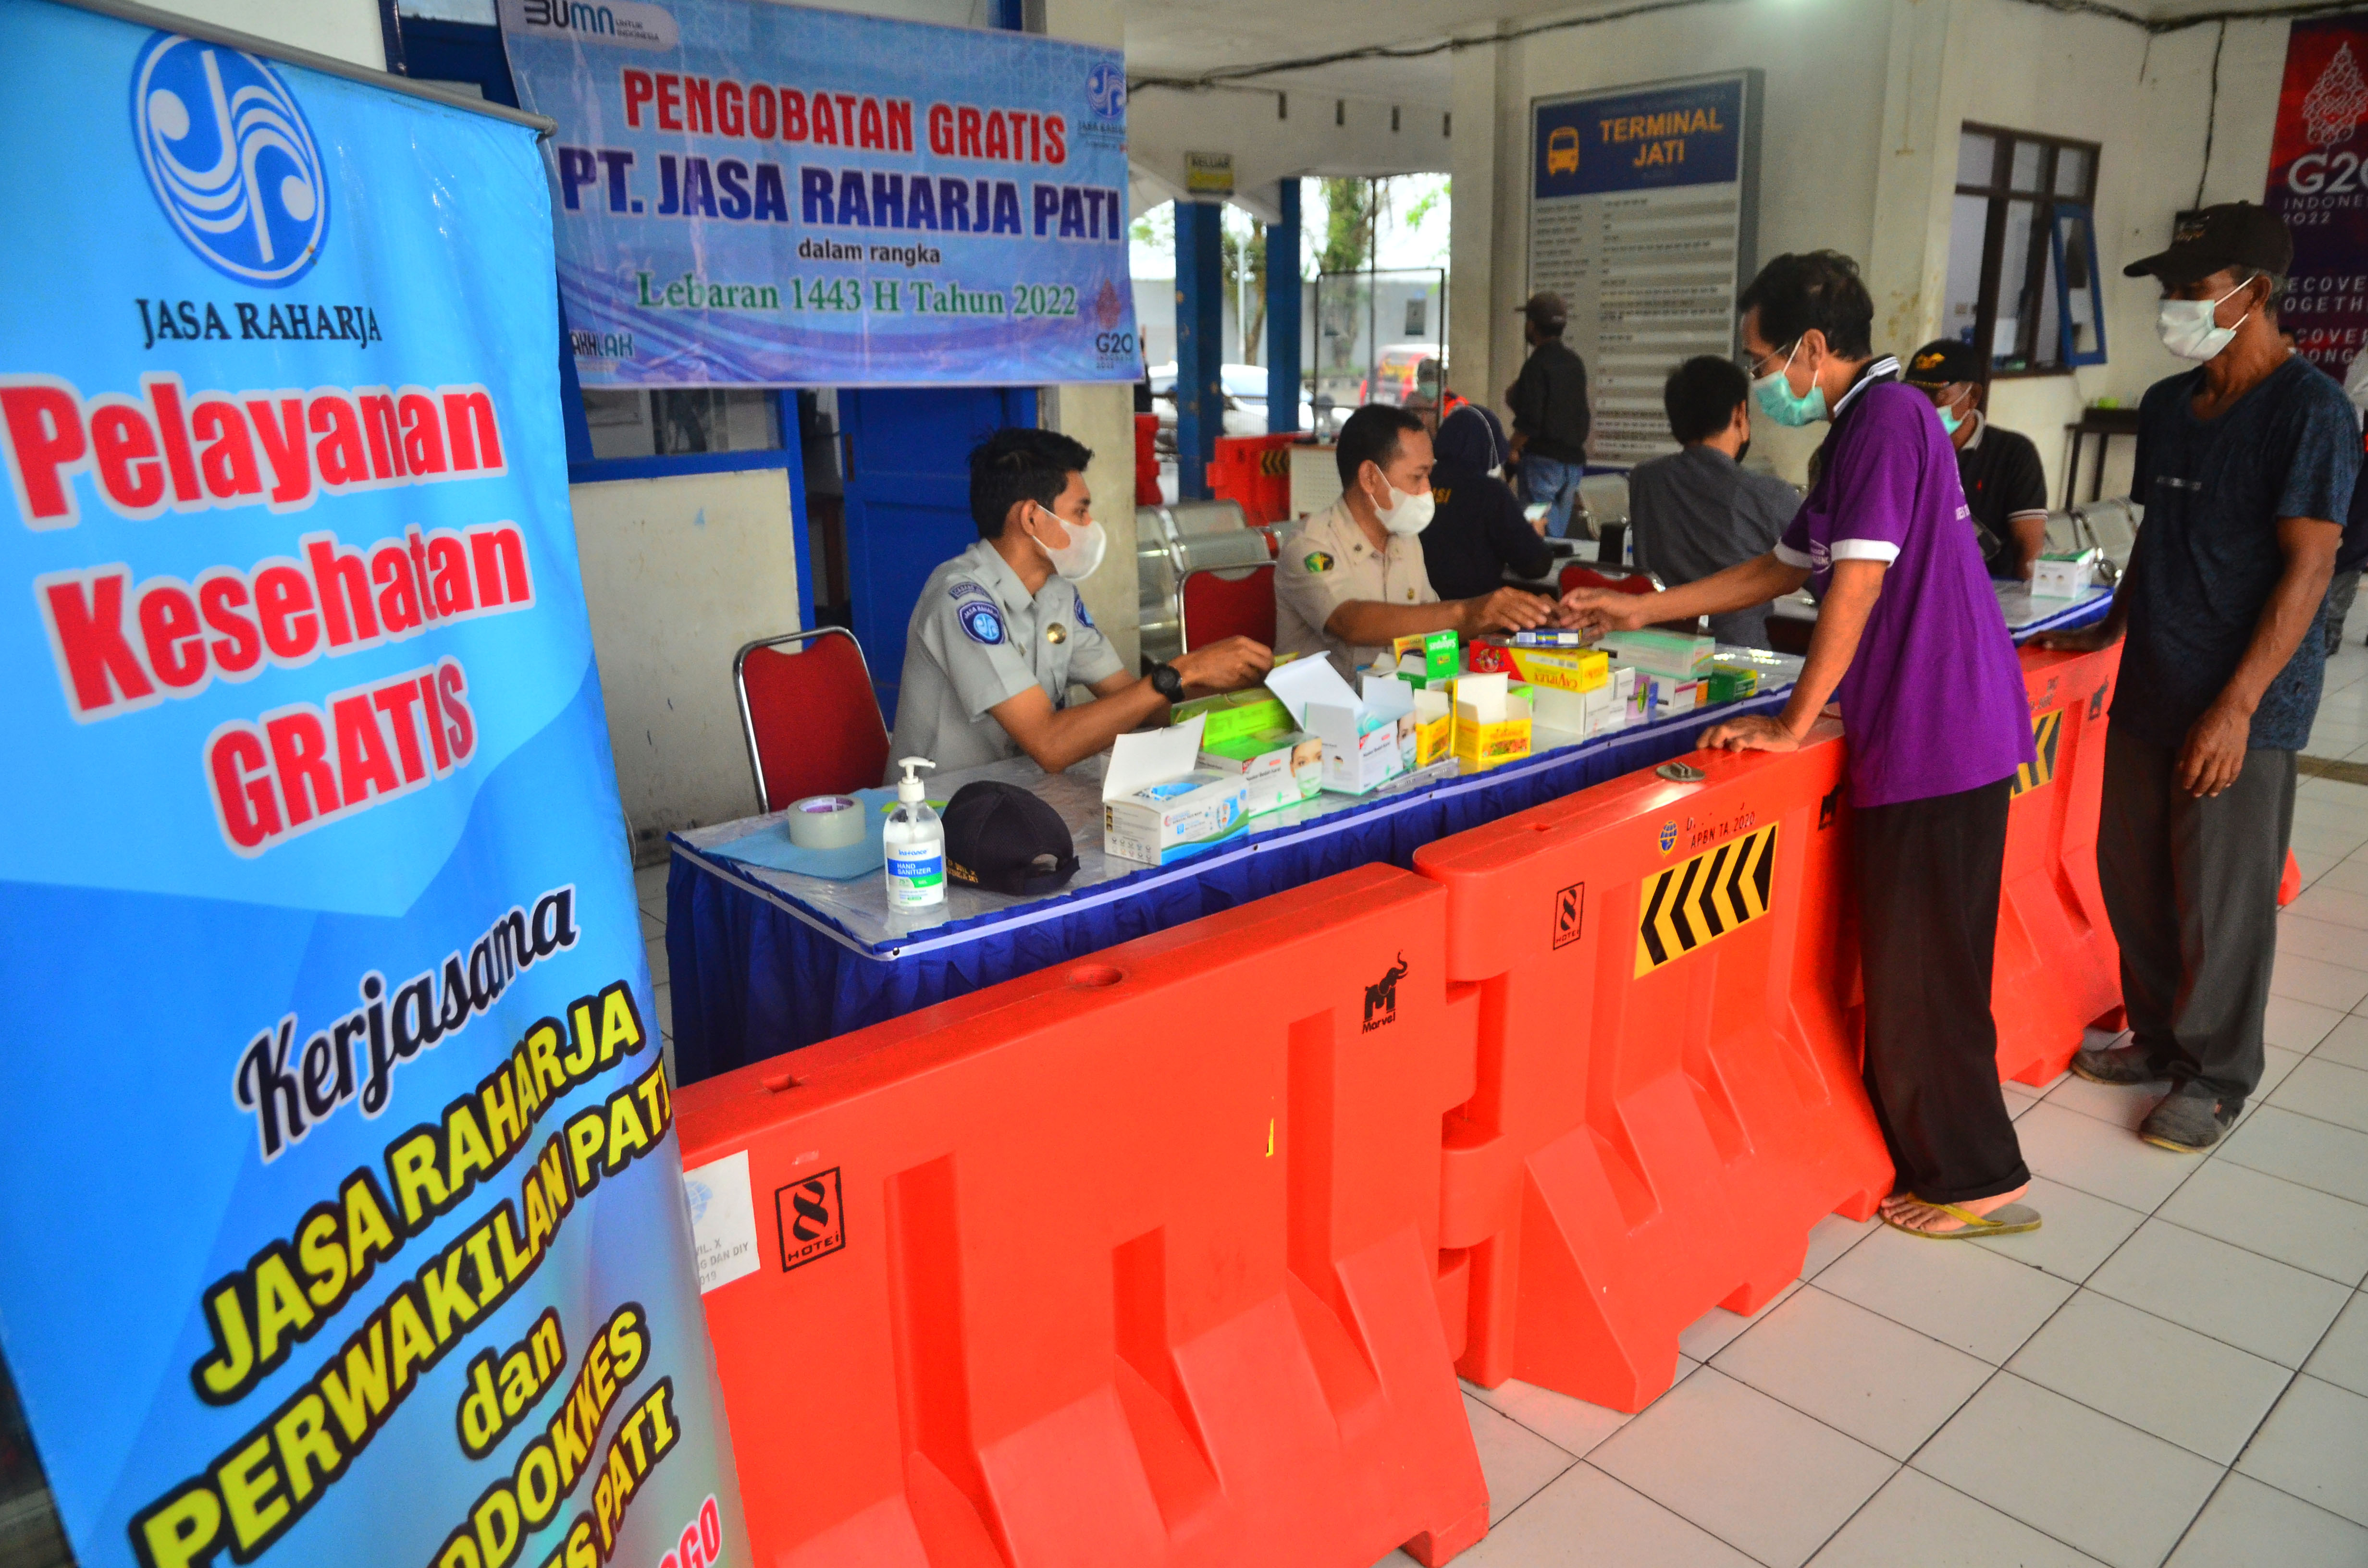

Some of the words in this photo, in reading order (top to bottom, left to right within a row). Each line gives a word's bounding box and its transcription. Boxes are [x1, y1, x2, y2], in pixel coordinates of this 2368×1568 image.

[625, 70, 913, 152] PENGOBATAN
[929, 103, 1066, 164] GRATIS
[1600, 107, 1724, 143] TERMINAL
[1632, 139, 1685, 168] JATI
[558, 147, 643, 213] PT.
[658, 154, 789, 222] JASA
[802, 166, 1022, 235] RAHARJA
[1033, 183, 1122, 240] PATI
[2283, 194, 2368, 210] INDONE
[799, 237, 863, 260] dalam
[870, 243, 940, 268] rangka
[636, 271, 780, 310] Lebaran
[792, 278, 862, 311] 1443
[873, 280, 901, 312] H
[910, 280, 1005, 315] Tahun
[1013, 284, 1078, 316] 2022
[2283, 296, 2368, 313] OGETH
[2286, 275, 2368, 294] ECOVE
[135, 299, 234, 350] JASA
[234, 303, 383, 349] RAHARJA
[1096, 332, 1133, 353] G20
[0, 380, 505, 521] Pelayanan
[46, 526, 531, 711] Kesehatan
[209, 663, 474, 849] GRATIS
[1690, 826, 1715, 849] APBN
[237, 886, 575, 1155] Kerjasama
[202, 1177, 393, 1394] JASA
[390, 990, 641, 1224] RAHARJA
[710, 1249, 730, 1266] DAN
[733, 1241, 748, 1256] DIY
[715, 1237, 721, 1249] X
[700, 1271, 716, 1286] 019
[143, 1141, 568, 1568] PERWAKILAN
[568, 1057, 670, 1188] PATI
[461, 1317, 564, 1450] dan
[595, 1385, 673, 1552] PATI
[660, 1497, 721, 1568] GO
